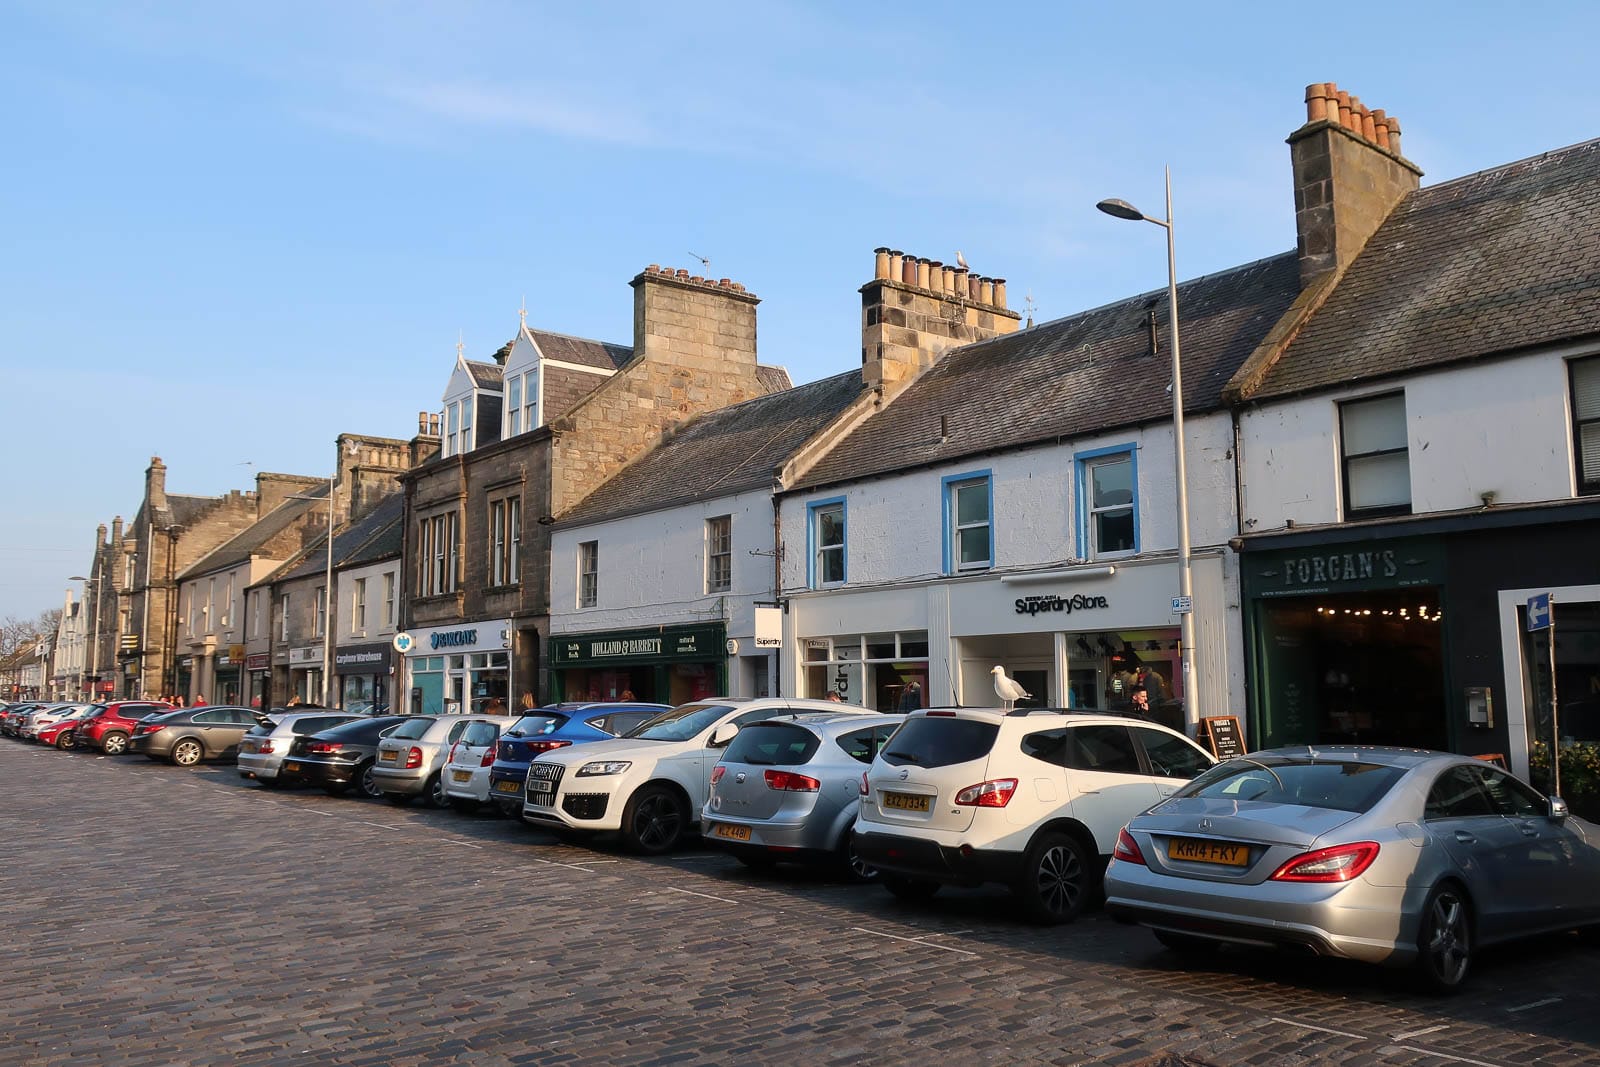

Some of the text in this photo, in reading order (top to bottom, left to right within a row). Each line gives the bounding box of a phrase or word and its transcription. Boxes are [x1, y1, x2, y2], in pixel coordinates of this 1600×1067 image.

[1284, 550, 1397, 585] FORGAN'S
[438, 630, 477, 648] BARCLAYS
[591, 638, 662, 657] HOLLAND & BARRETT
[756, 637, 781, 646] Superdry
[1176, 841, 1240, 861] KR14 FKY
